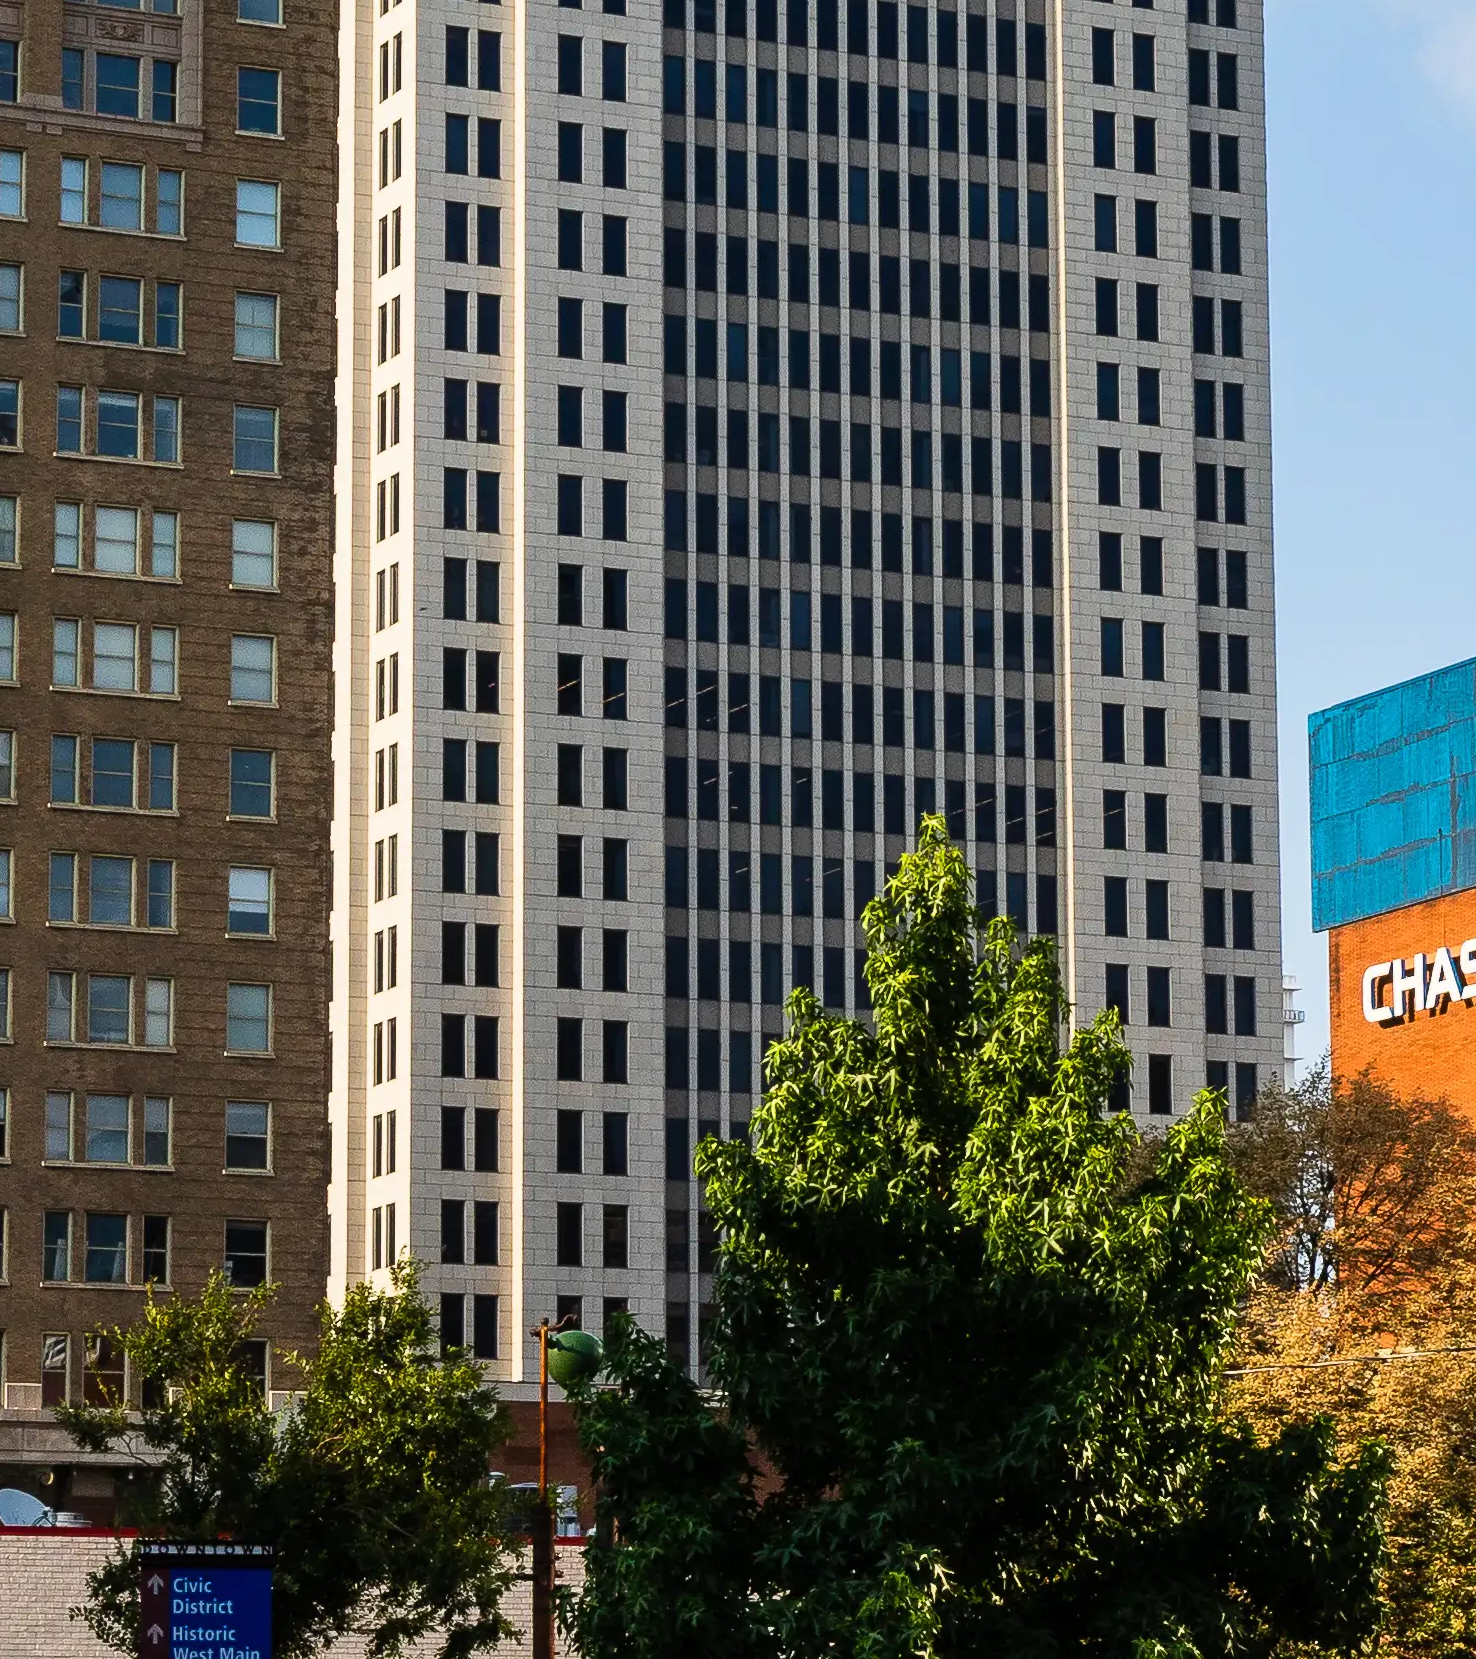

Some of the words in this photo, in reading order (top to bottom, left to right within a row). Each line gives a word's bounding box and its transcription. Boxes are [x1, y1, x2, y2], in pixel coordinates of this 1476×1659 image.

[143, 1545, 272, 1554] DOWNTOWN
[173, 1577, 212, 1593] Civic
[173, 1598, 233, 1614] District
[173, 1625, 236, 1641] Historic
[174, 1647, 214, 1659] West
[220, 1646, 260, 1659] Main
